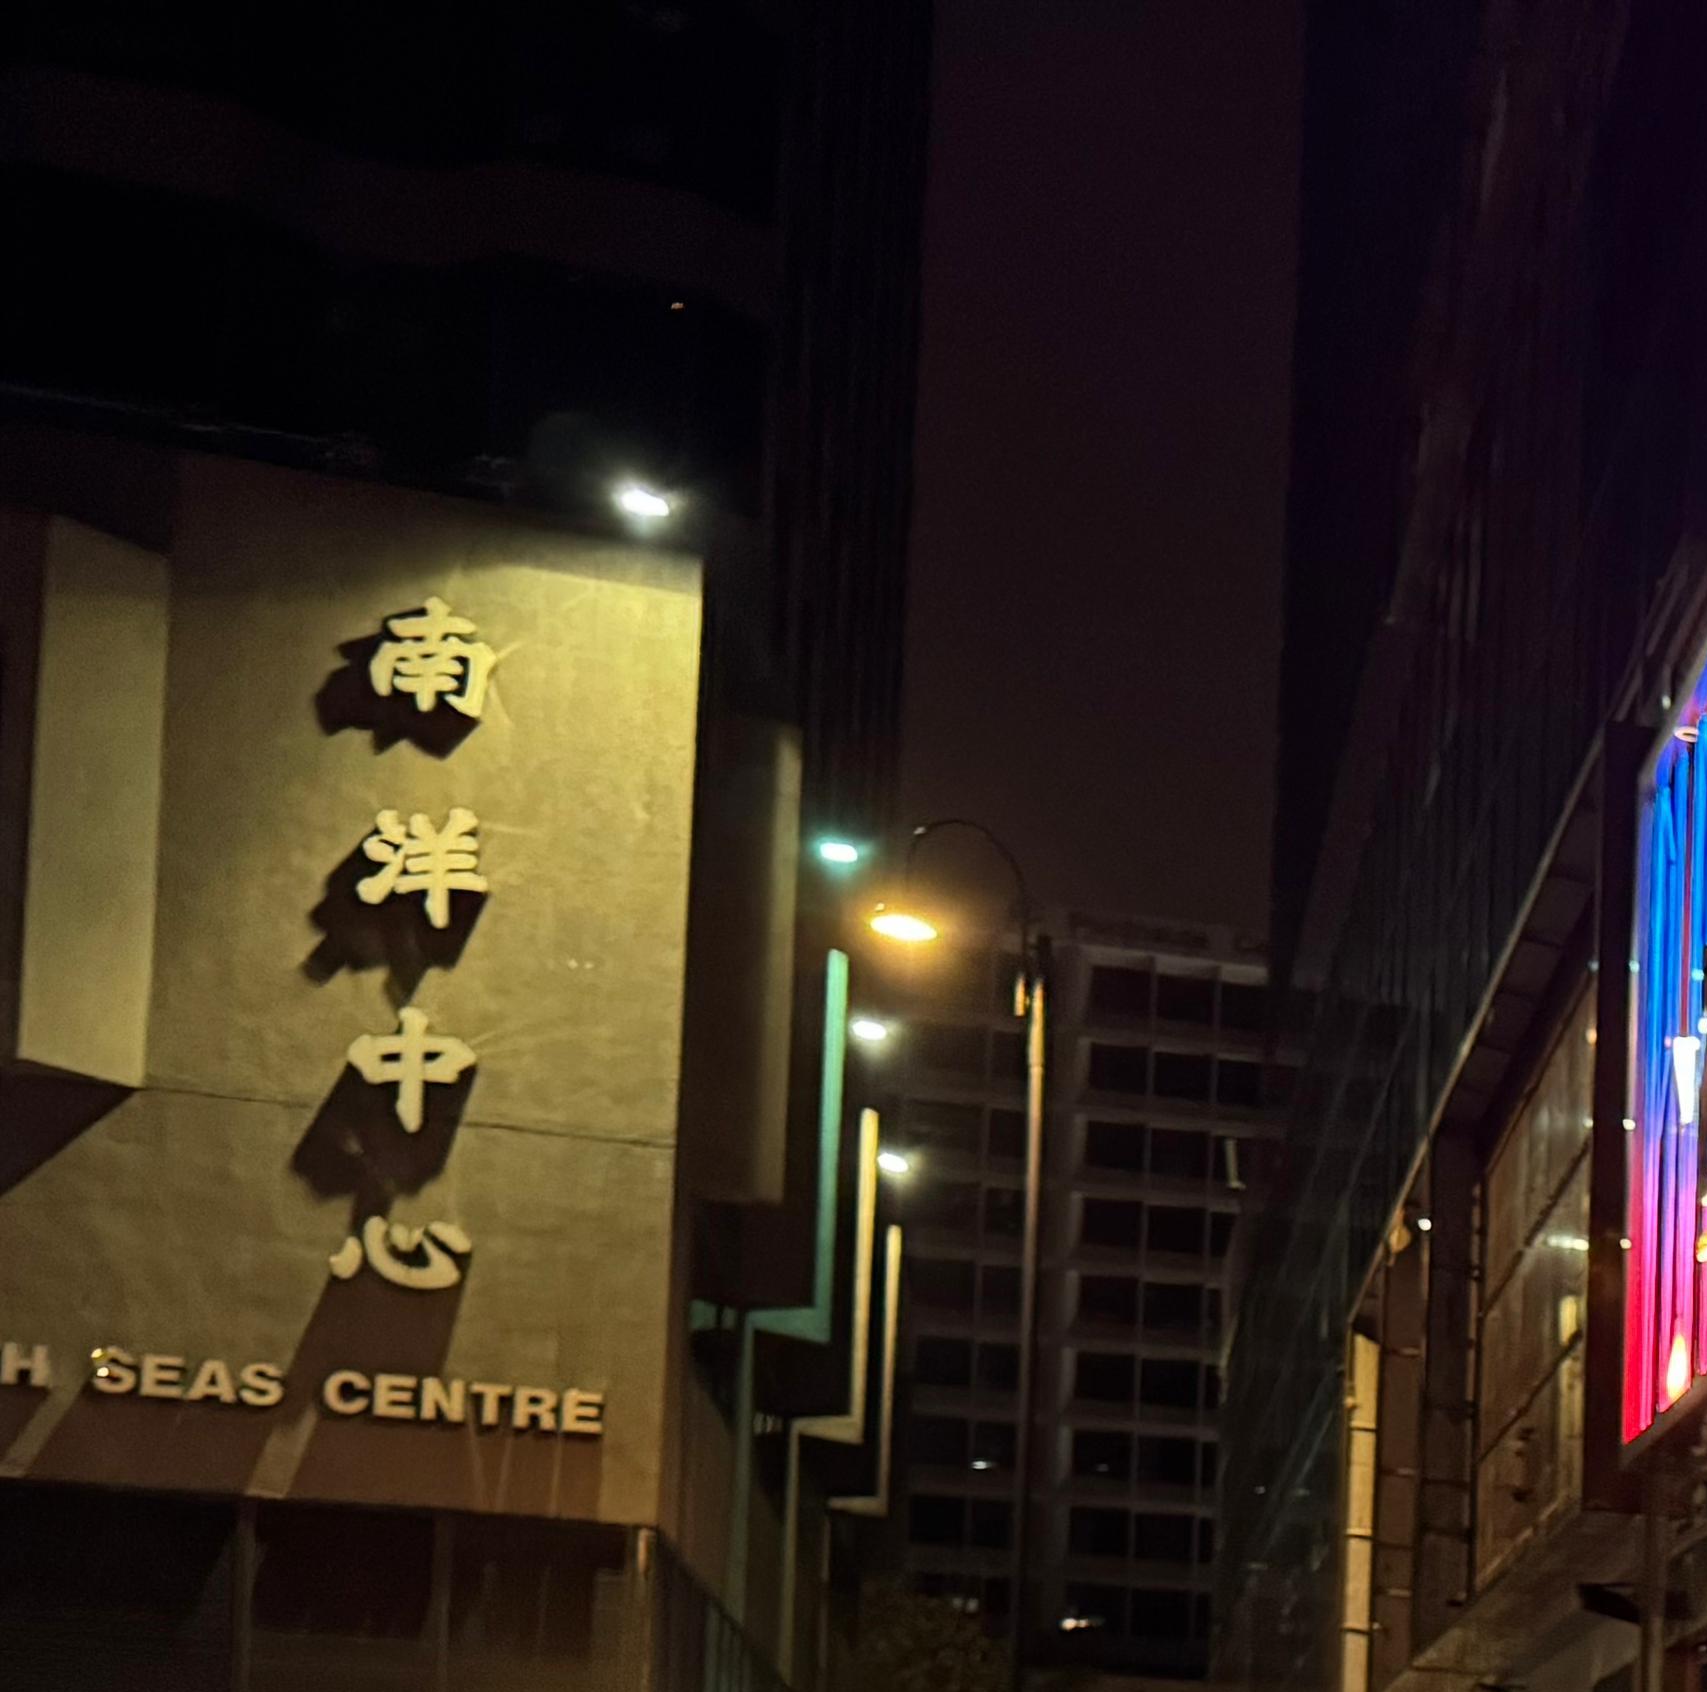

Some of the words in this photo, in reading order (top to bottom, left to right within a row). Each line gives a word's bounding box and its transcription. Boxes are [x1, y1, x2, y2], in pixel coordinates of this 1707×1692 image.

[328, 596, 495, 1290] 南洋中心
[91, 1345, 285, 1409] SEAS
[322, 1367, 604, 1436] CENTRE
